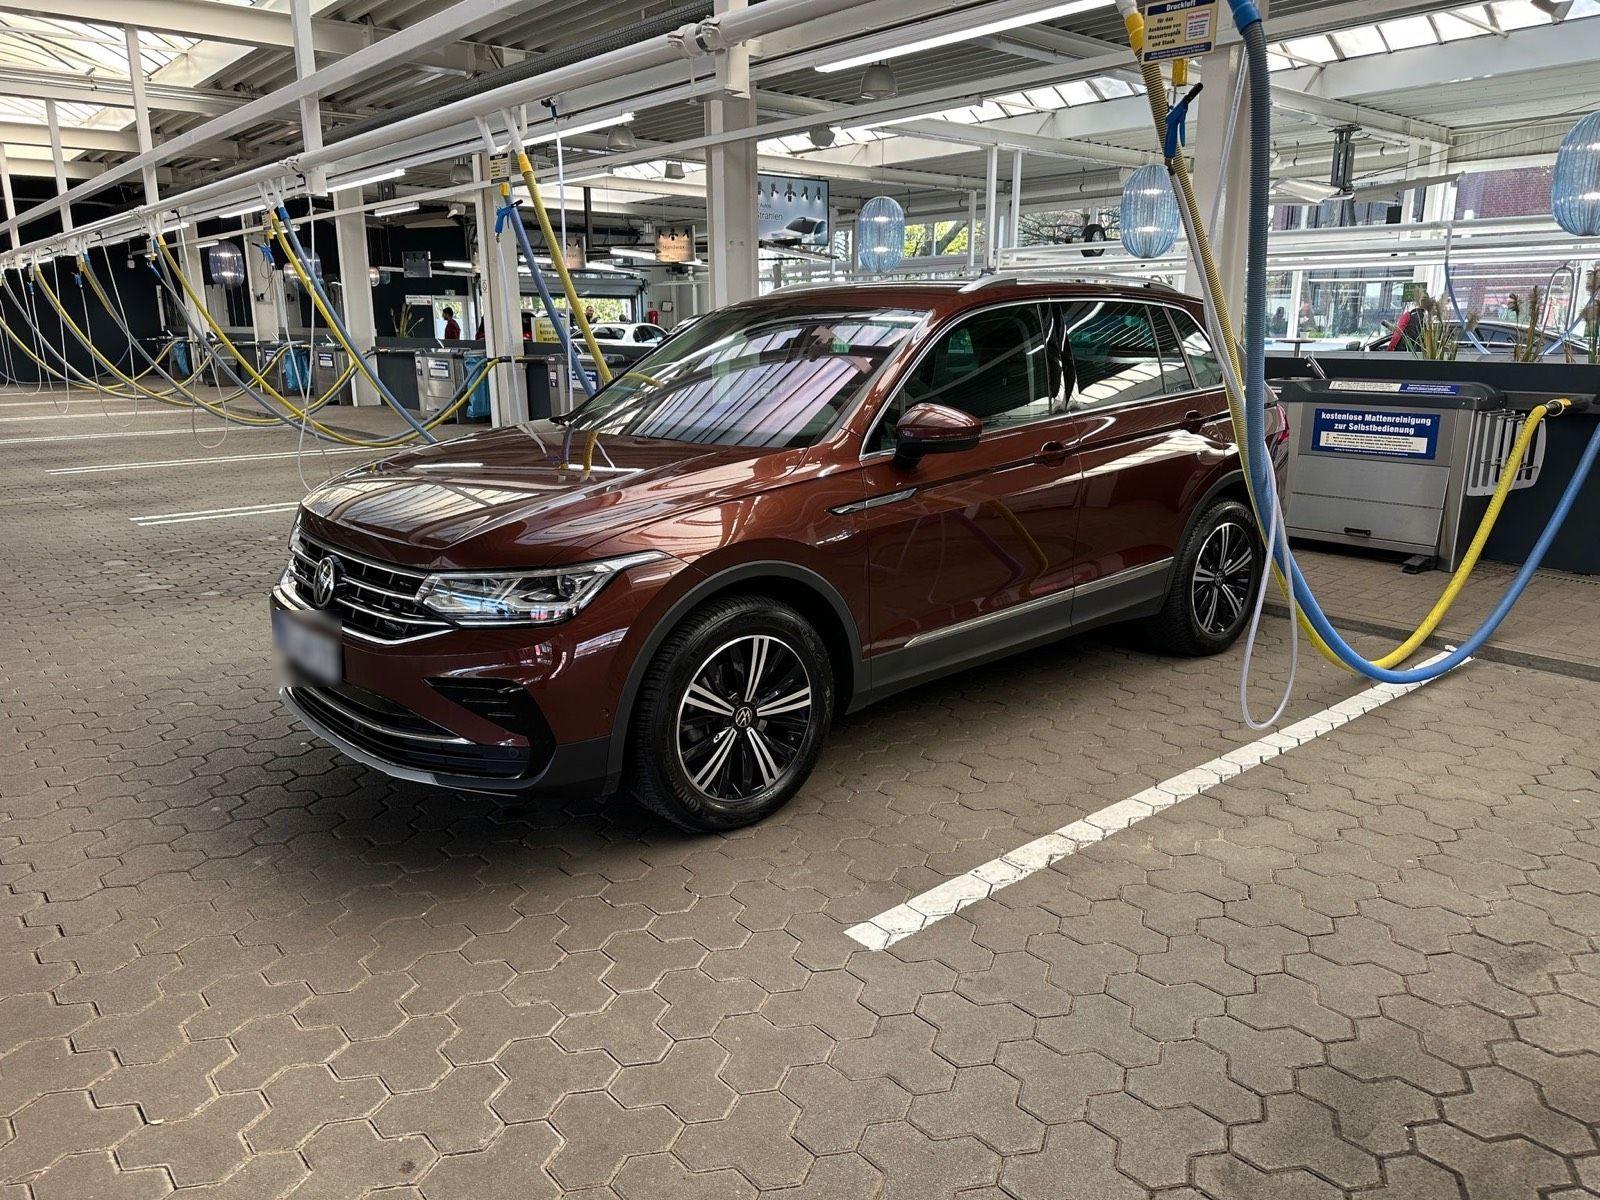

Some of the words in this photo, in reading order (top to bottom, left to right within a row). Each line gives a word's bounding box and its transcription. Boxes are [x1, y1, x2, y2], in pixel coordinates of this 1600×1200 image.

[1166, 0, 1196, 11] Druckluft
[1148, 24, 1172, 32] Ausblasen
[1321, 411, 1362, 421] kostenlose
[1364, 413, 1431, 425] Mattenreinigung
[1334, 422, 1347, 430] zur
[1348, 422, 1415, 435] Selbstbedienung
